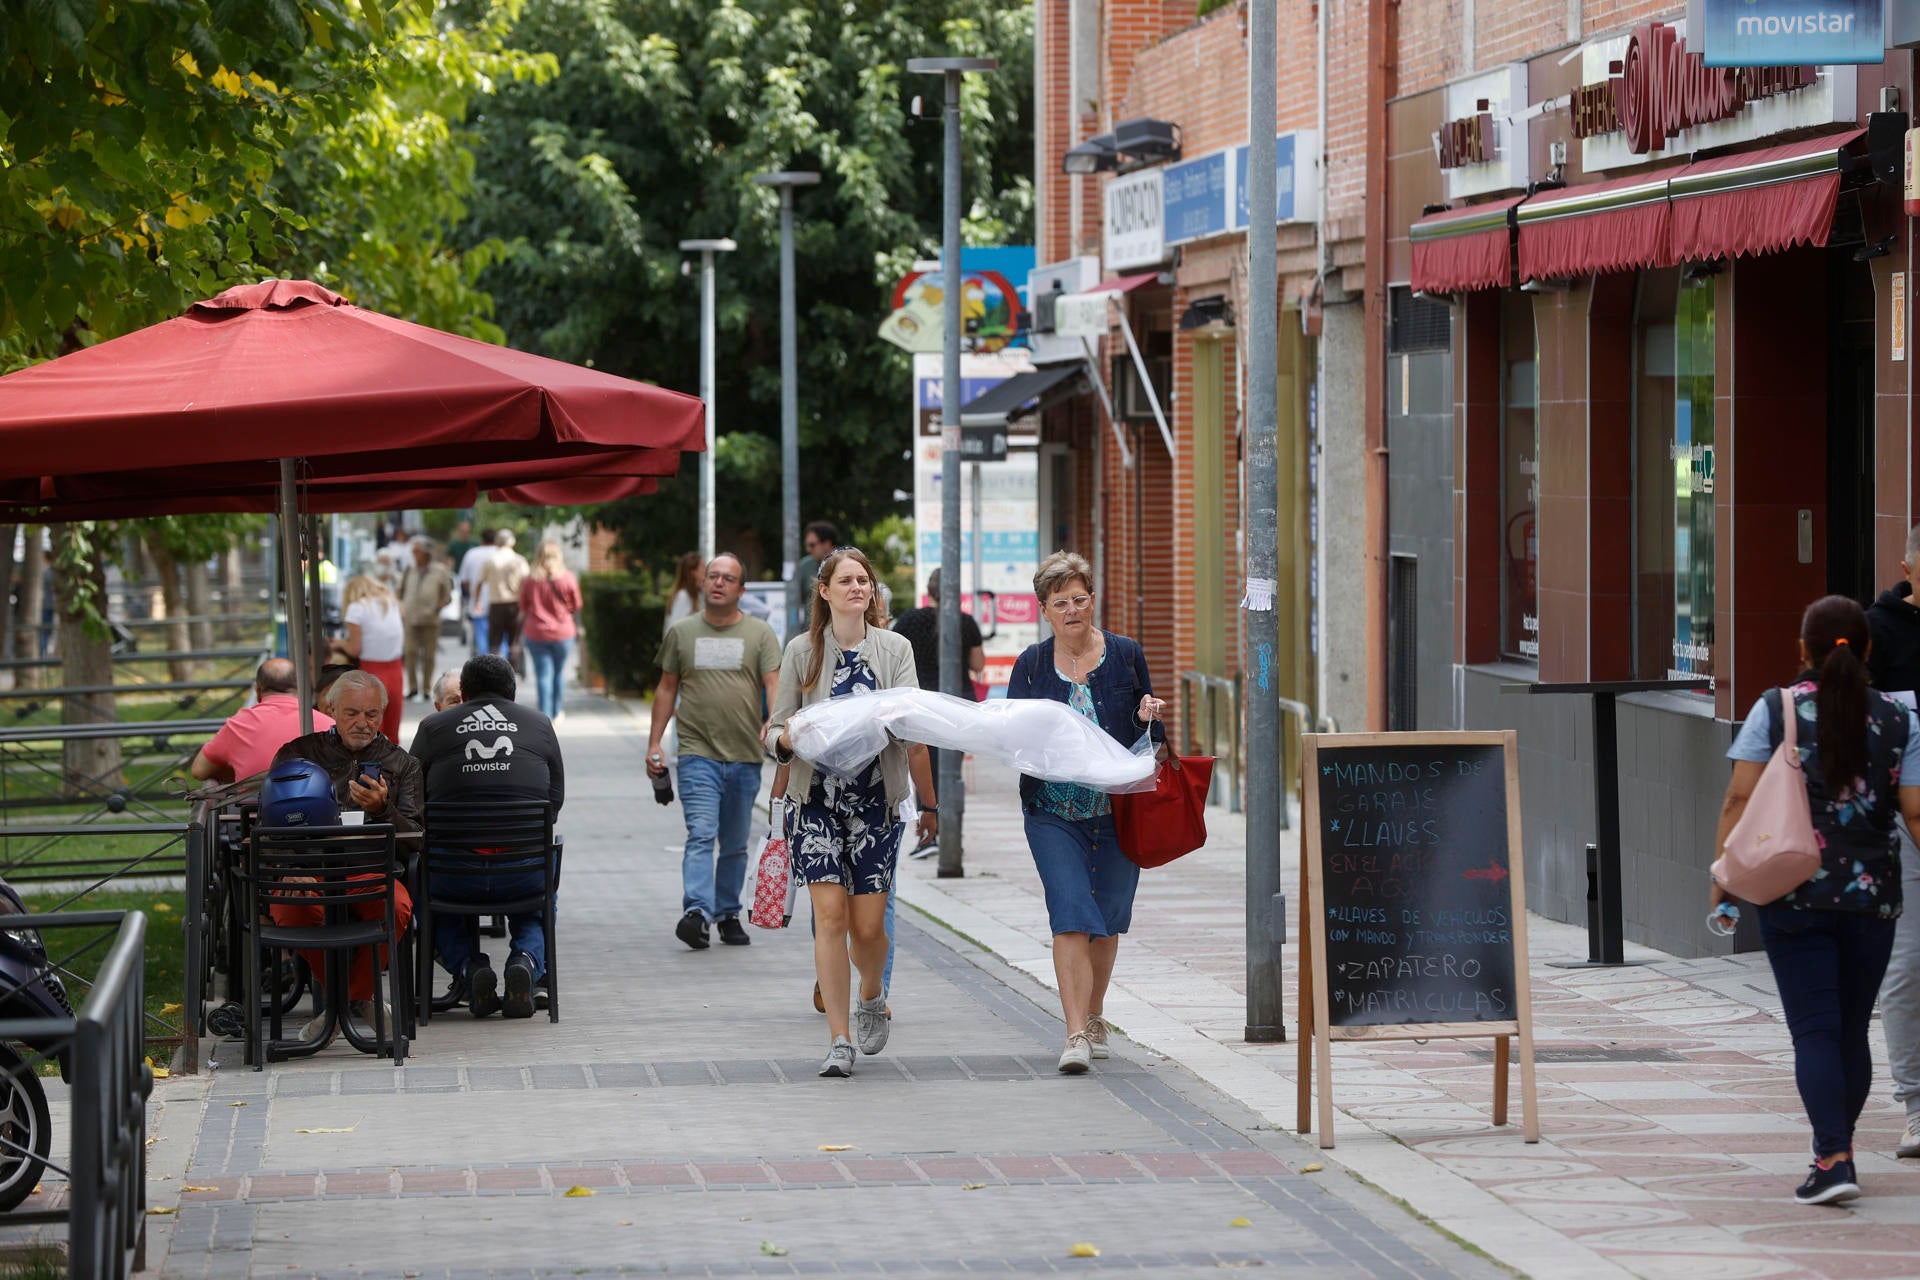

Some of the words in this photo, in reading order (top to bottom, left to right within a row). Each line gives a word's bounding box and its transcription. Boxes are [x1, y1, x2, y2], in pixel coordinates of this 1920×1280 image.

[1737, 11, 1855, 36] movistar
[456, 720, 518, 734] adidas
[462, 762, 511, 773] movistar
[1334, 761, 1443, 788] MANDOS
[1458, 760, 1484, 777] DE
[1336, 788, 1437, 814] GARAJE
[1344, 818, 1440, 847] LLAVES
[1328, 852, 1357, 874] EN
[1338, 907, 1387, 923] LLAVES
[1402, 909, 1421, 925] DE
[1329, 931, 1350, 942] CON
[1356, 930, 1396, 945] MANDO
[1347, 954, 1481, 980] ZAPATERO
[1348, 988, 1506, 1014] MATRICULAS
